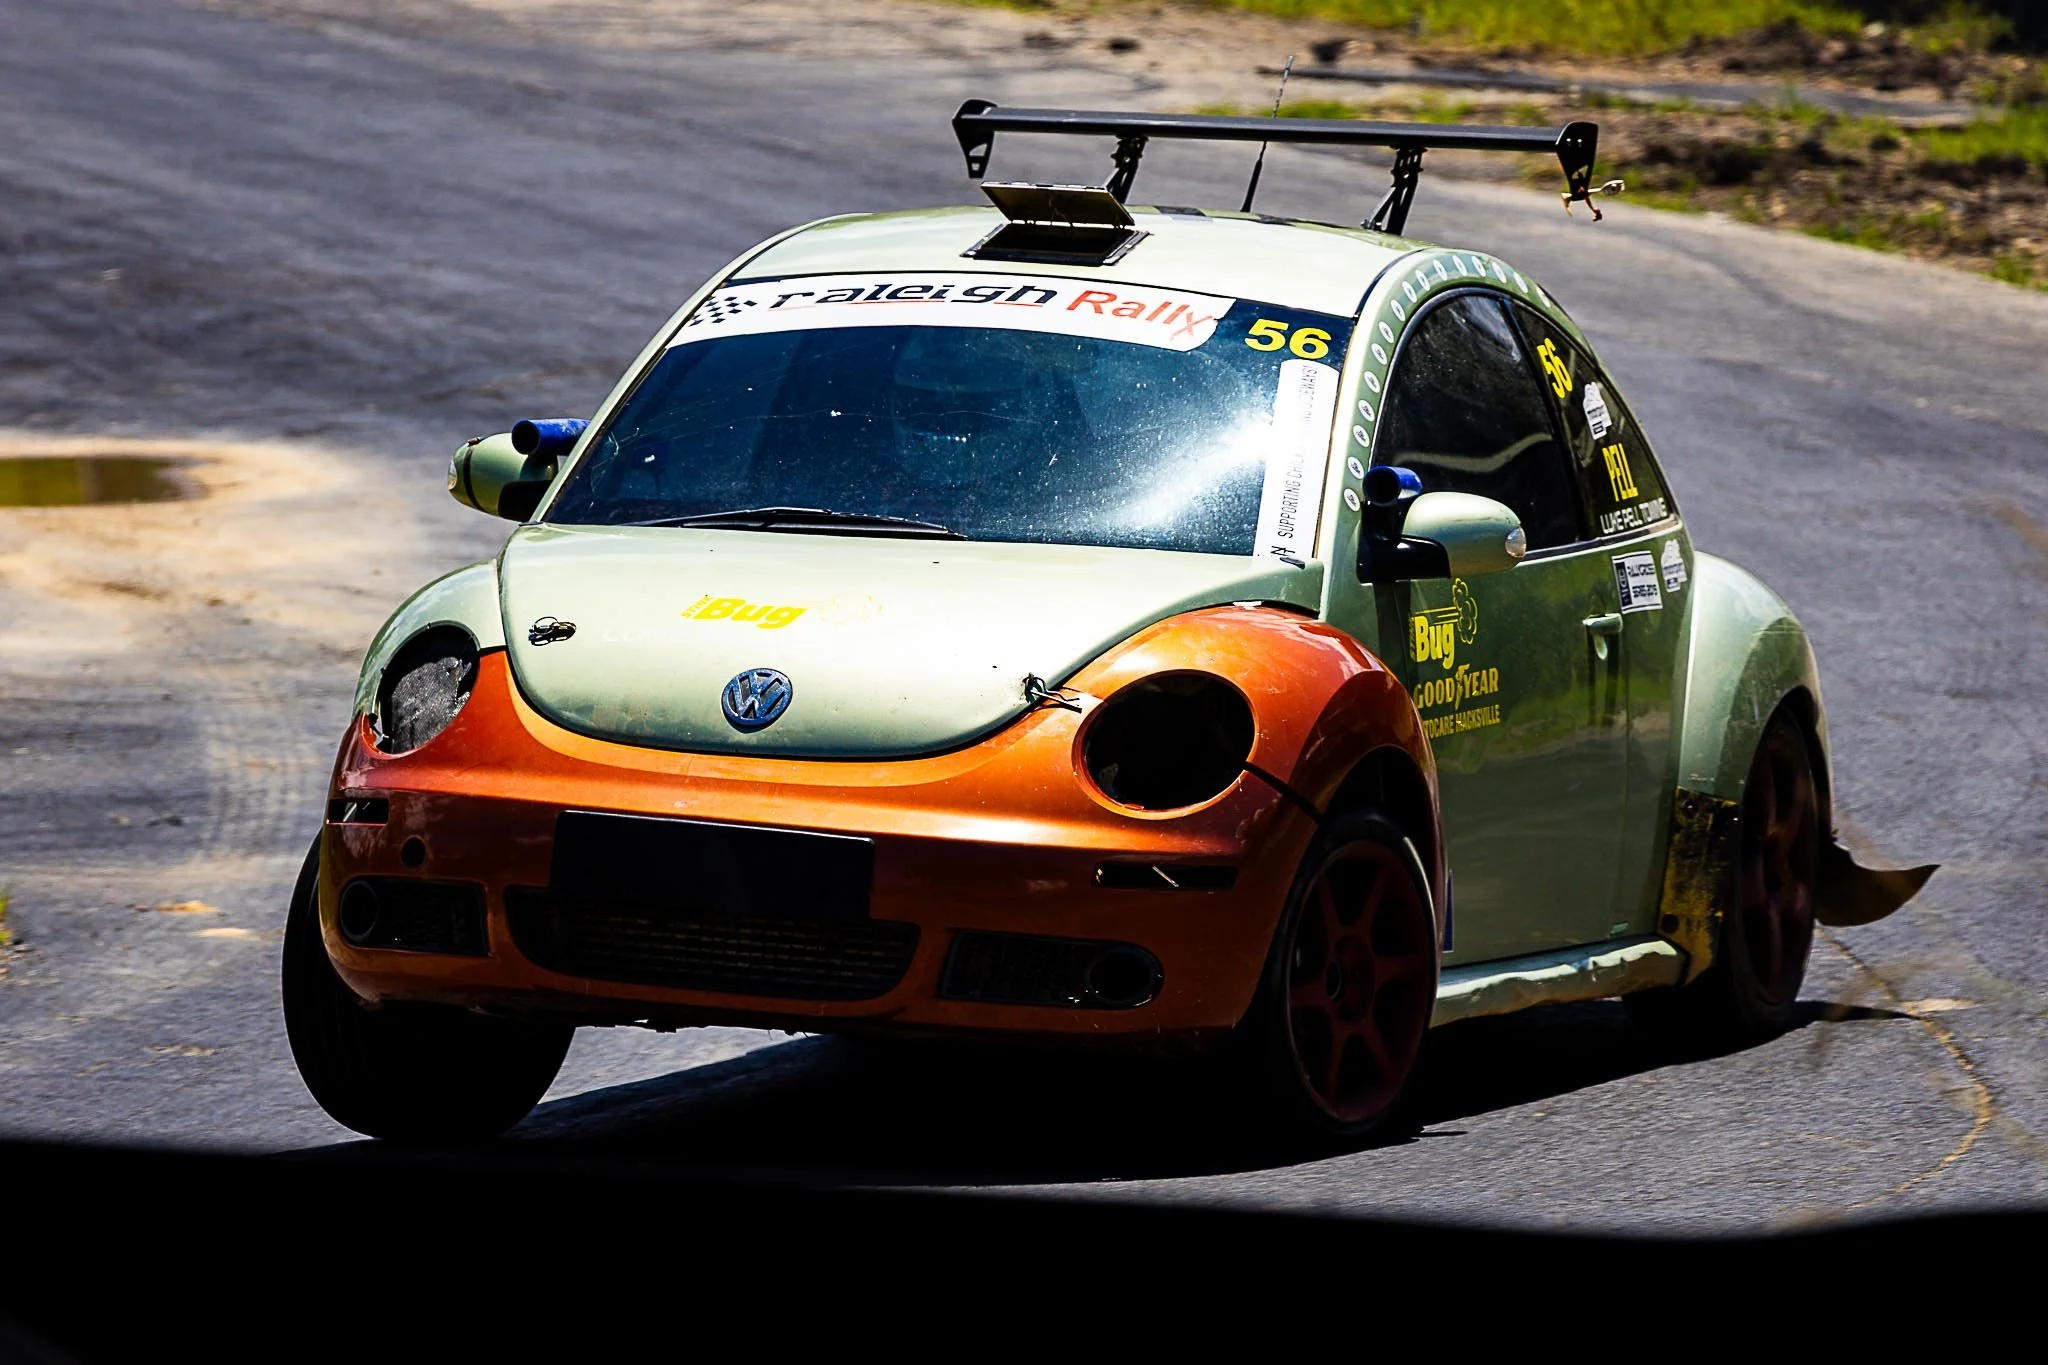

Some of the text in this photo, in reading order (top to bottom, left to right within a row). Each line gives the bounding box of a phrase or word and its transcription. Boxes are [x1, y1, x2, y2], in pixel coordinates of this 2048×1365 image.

[769, 283, 1058, 309] raleigh
[1245, 318, 1332, 360] 56
[1536, 337, 1573, 399] 56
[1602, 443, 1639, 502] PELL
[1277, 479, 1301, 539] SUPPORTING
[692, 597, 808, 629] Bug
[1414, 615, 1456, 670] Bug
[1413, 665, 1499, 710] GOODYEAR
[1422, 713, 1455, 740] TOCARE
